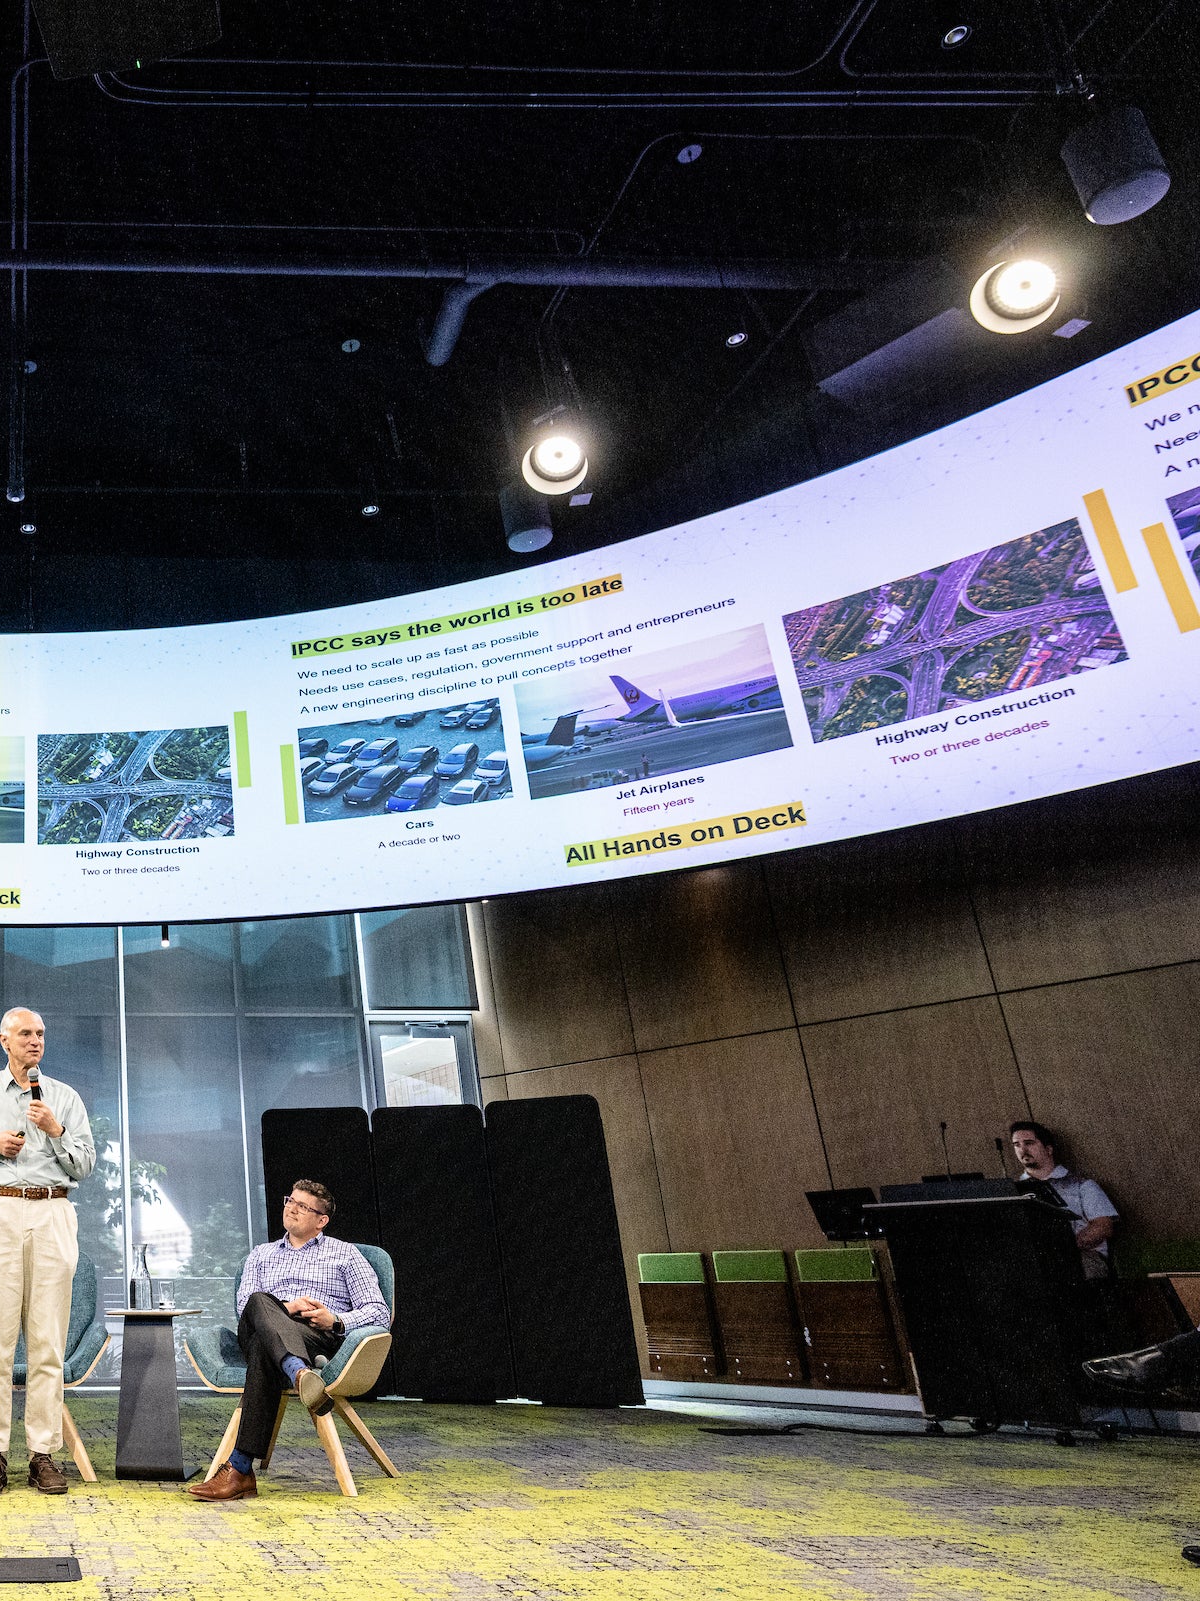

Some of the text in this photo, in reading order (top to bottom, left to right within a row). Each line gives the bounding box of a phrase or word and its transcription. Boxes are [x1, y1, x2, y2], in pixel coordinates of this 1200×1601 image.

[1143, 412, 1182, 431] We
[1153, 429, 1200, 455] Nee
[1164, 464, 1182, 478] A
[291, 579, 623, 657] IPCC says the world is too late
[297, 629, 539, 680] We need to scale up as fast as possible
[298, 598, 736, 697] Needs use cases, regulation, government support and entrepreneurs
[300, 645, 633, 715] A new engineering discipline to pull concepts together
[875, 688, 1076, 747] Highway Construction
[888, 720, 1051, 765] Two or three decades
[616, 776, 705, 800] Jet Airplanes
[623, 796, 695, 817] Fifteen years
[405, 820, 435, 830] Cars
[566, 806, 807, 864] All Hands on Deck
[75, 846, 200, 860] Highway Construction
[377, 833, 461, 849] A decade or two
[80, 867, 101, 876] Two
[114, 867, 138, 875] three
[140, 864, 181, 874] decades
